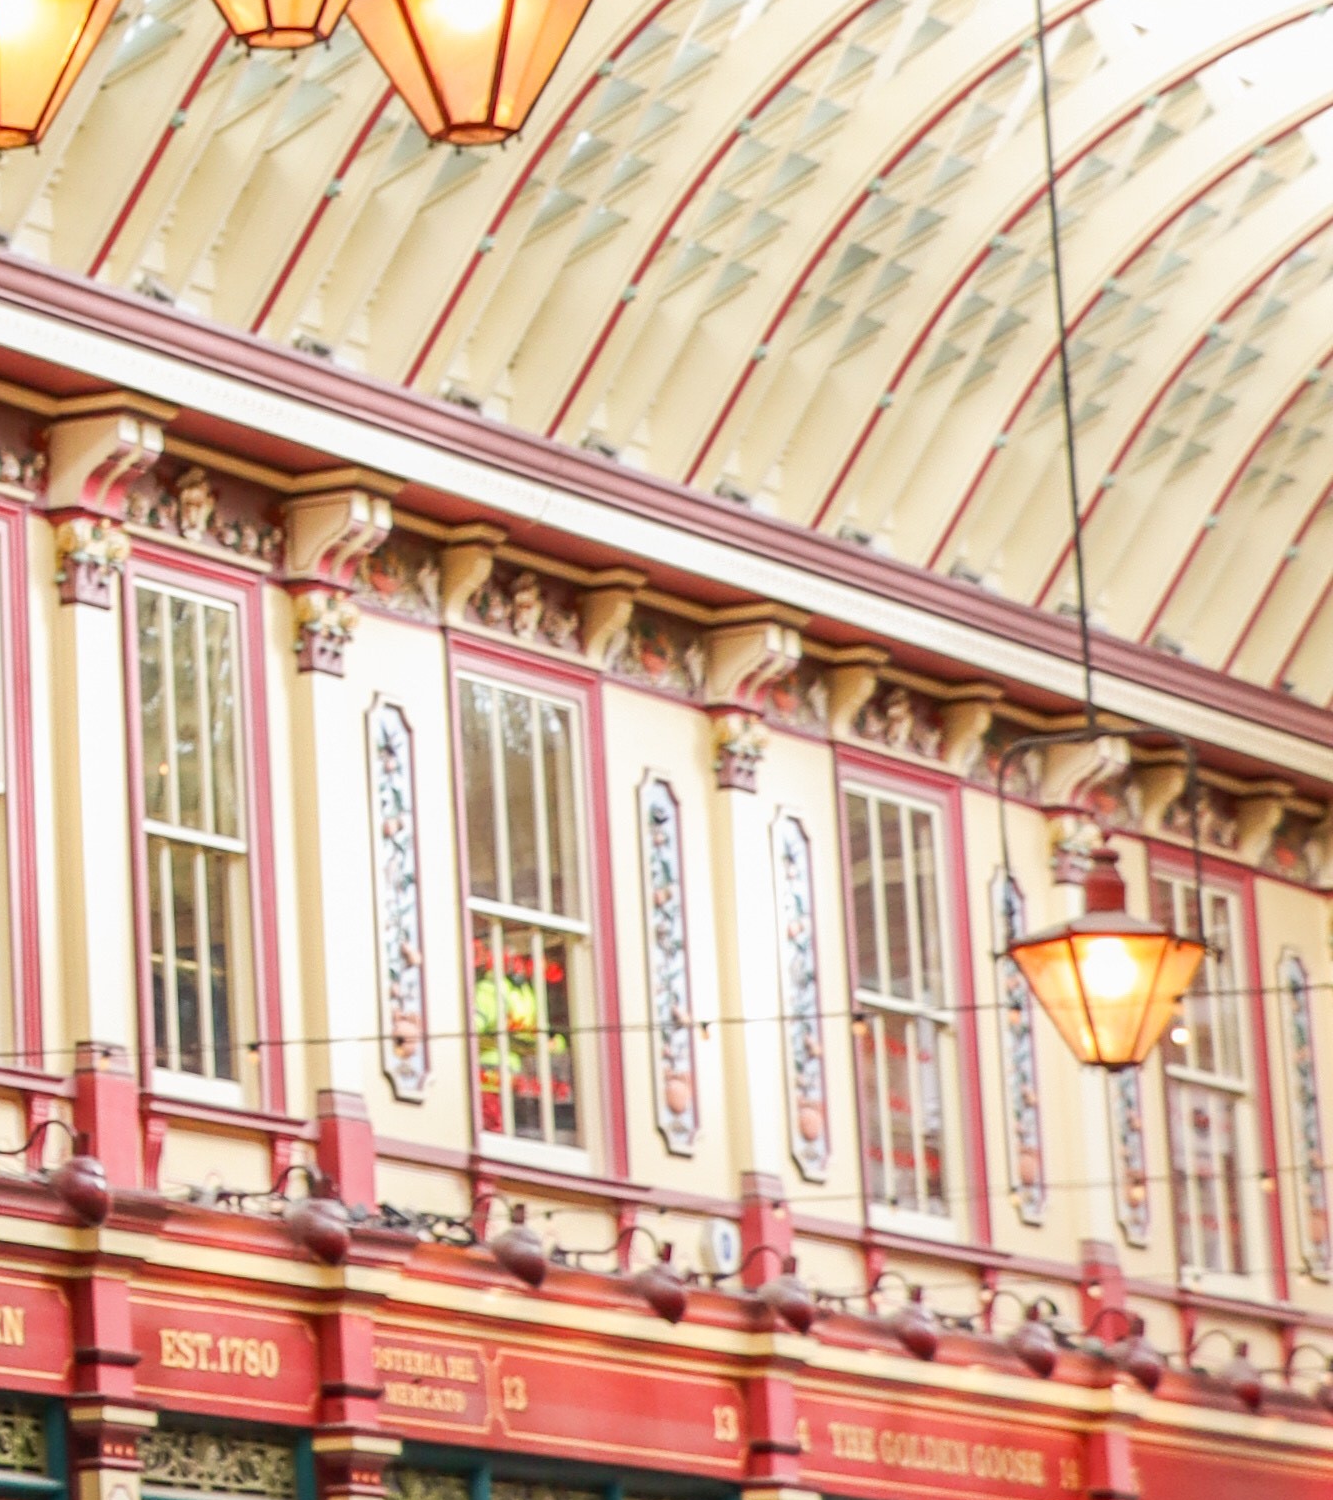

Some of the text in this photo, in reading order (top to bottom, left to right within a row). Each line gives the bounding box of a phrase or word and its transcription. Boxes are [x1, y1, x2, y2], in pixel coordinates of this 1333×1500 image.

[502, 1375, 529, 1412] 13
[712, 1405, 740, 1442] 13
[828, 1421, 1047, 1488] THE GOLDEN GOOSE
